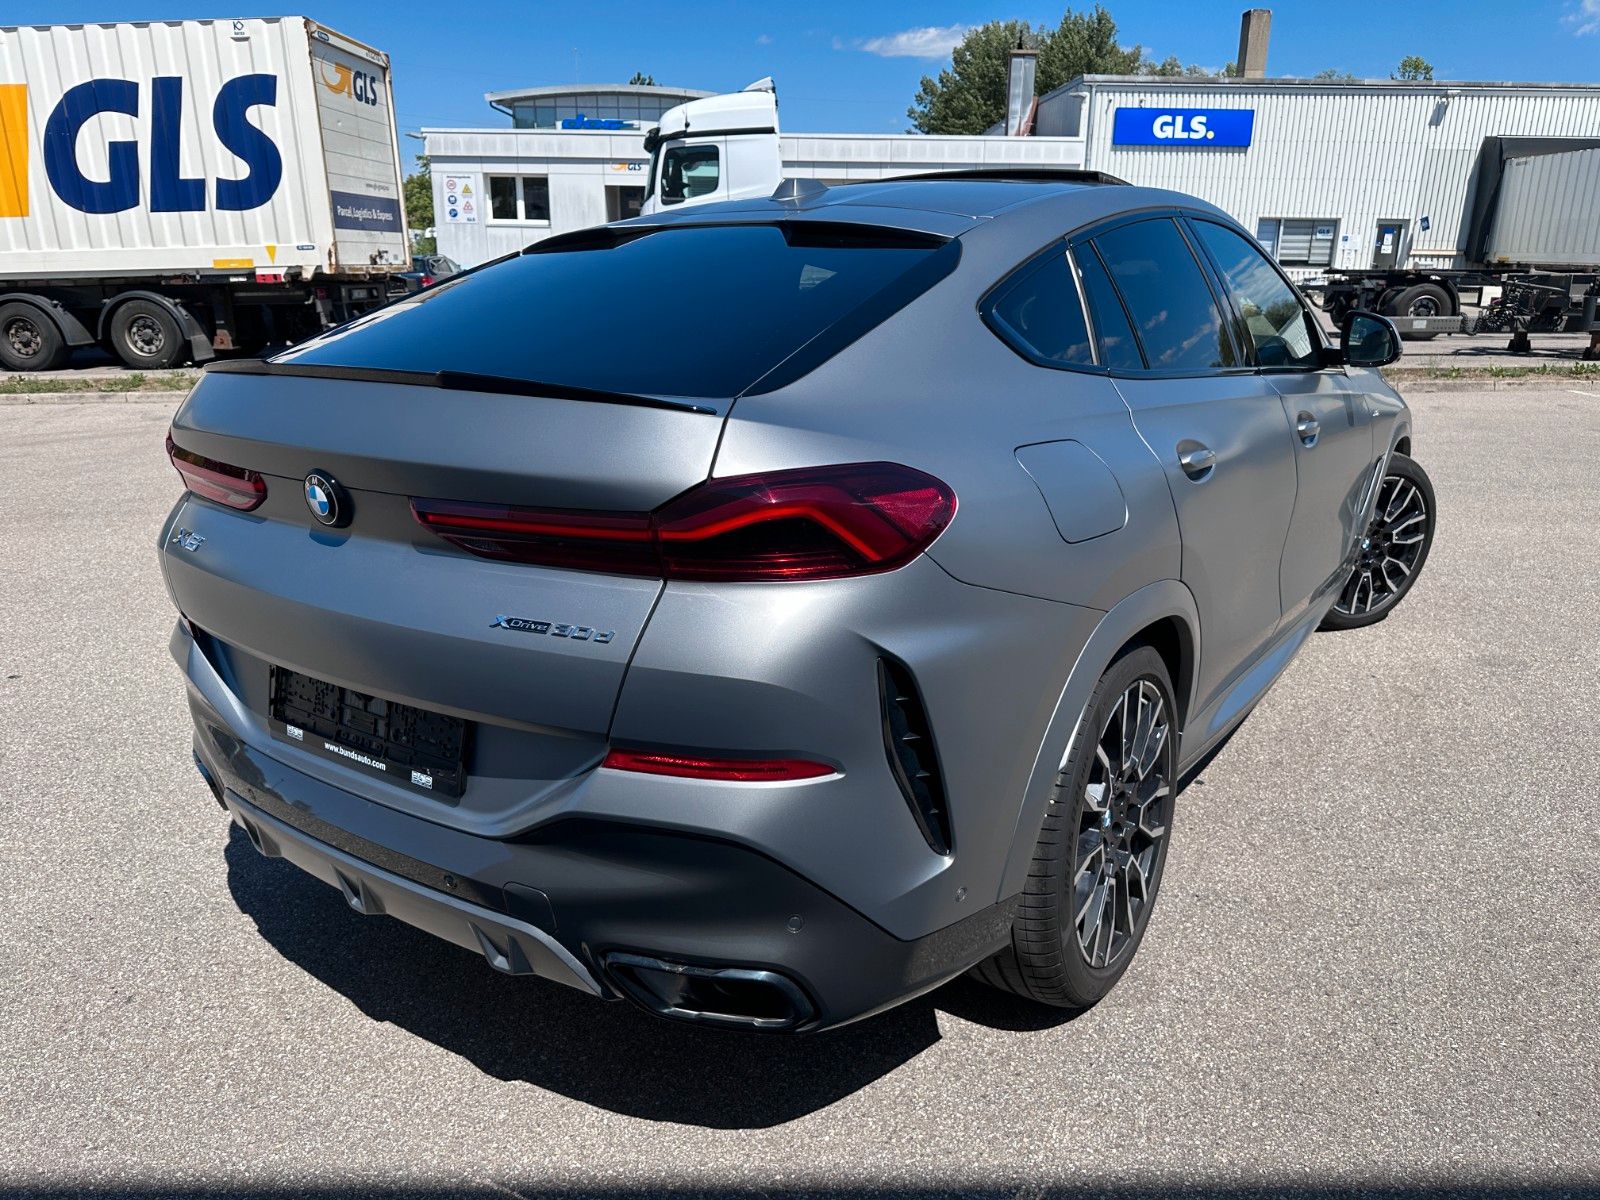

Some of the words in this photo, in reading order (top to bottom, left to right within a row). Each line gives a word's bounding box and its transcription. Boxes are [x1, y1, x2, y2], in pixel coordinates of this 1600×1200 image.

[353, 70, 377, 106] GLS
[43, 73, 283, 214] GLS
[628, 163, 641, 171] GLS
[172, 527, 206, 551] X6
[551, 623, 615, 644] 30d
[324, 742, 386, 771] www.bundsauto.com
